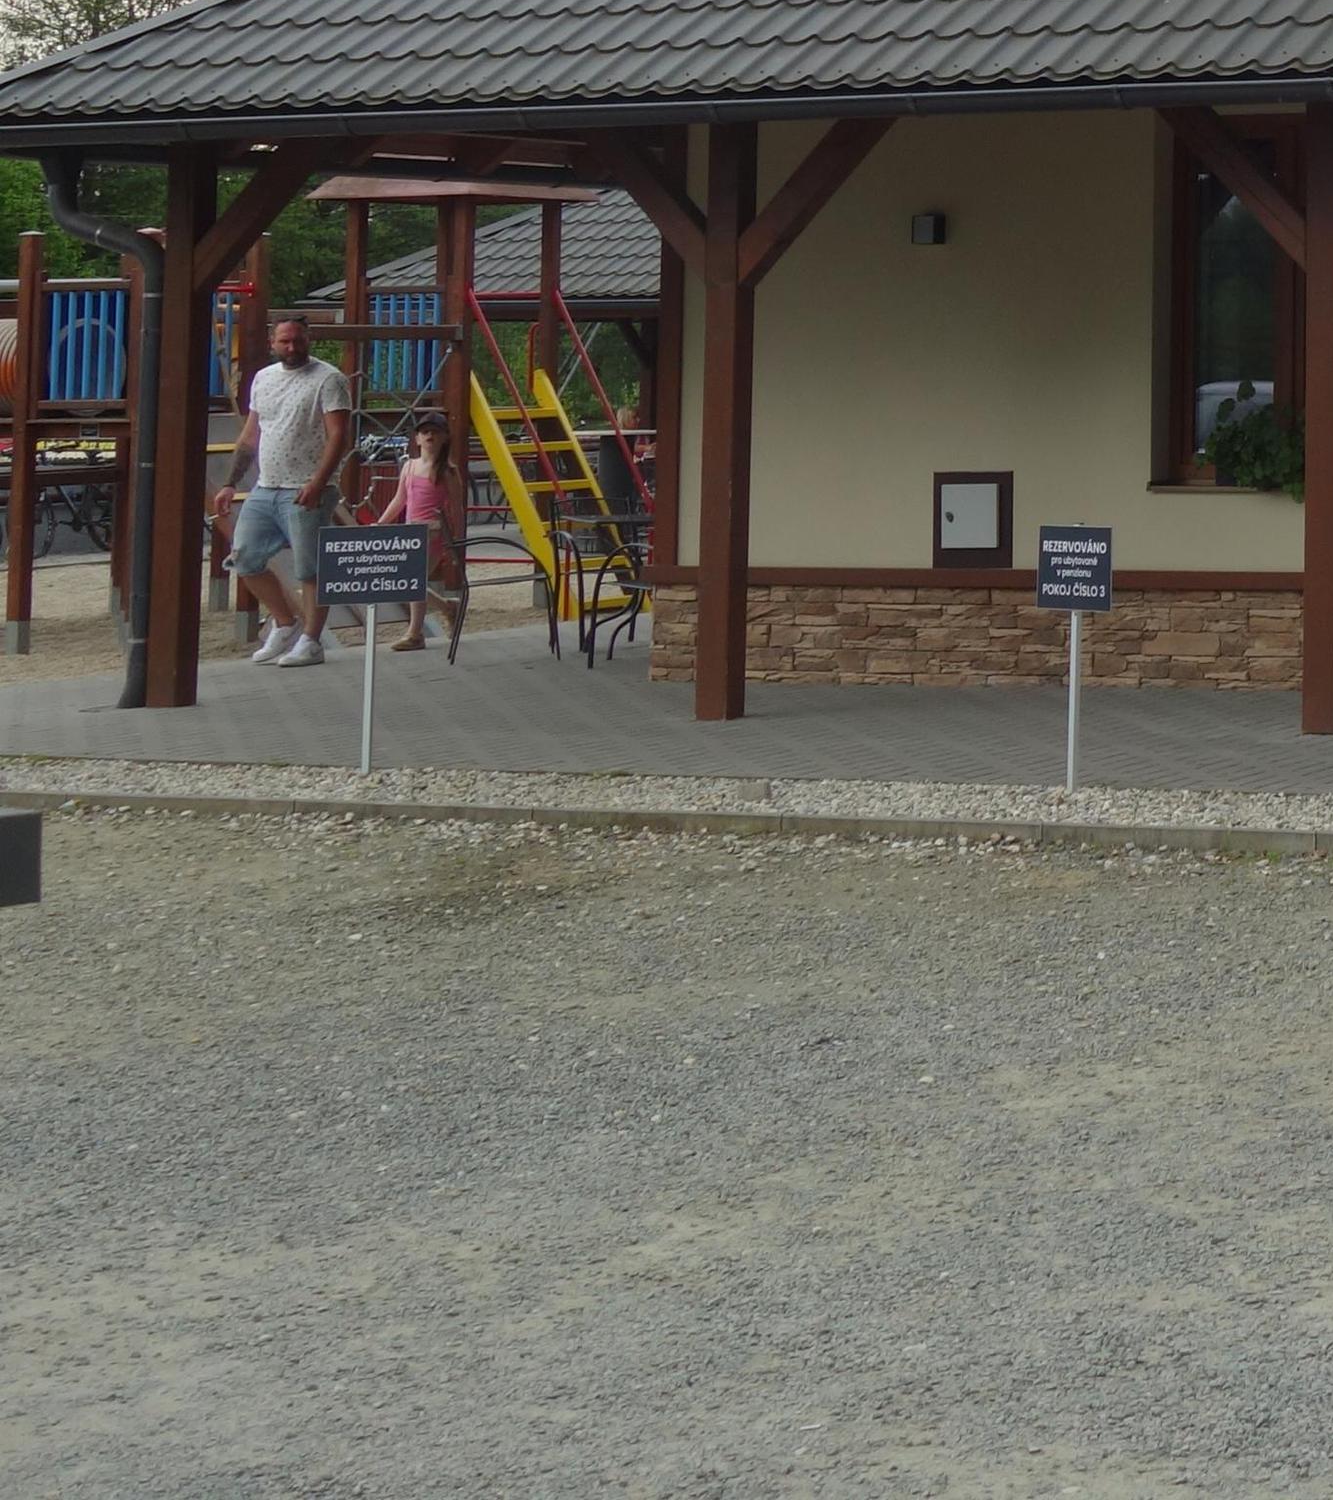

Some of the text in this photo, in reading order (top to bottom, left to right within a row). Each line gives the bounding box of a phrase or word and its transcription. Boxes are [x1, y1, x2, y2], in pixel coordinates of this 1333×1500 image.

[325, 536, 421, 553] REZERVOVÁNO
[1042, 539, 1107, 554] REZERVOVÁNO
[338, 555, 355, 566] pro
[1051, 557, 1062, 566] pro
[354, 565, 398, 576] penzionu
[1062, 568, 1092, 579] penzionu
[325, 577, 419, 593] POKOJ ČÍSLO 2
[1042, 582, 1106, 598] POKOJ ČÍSLO 3
